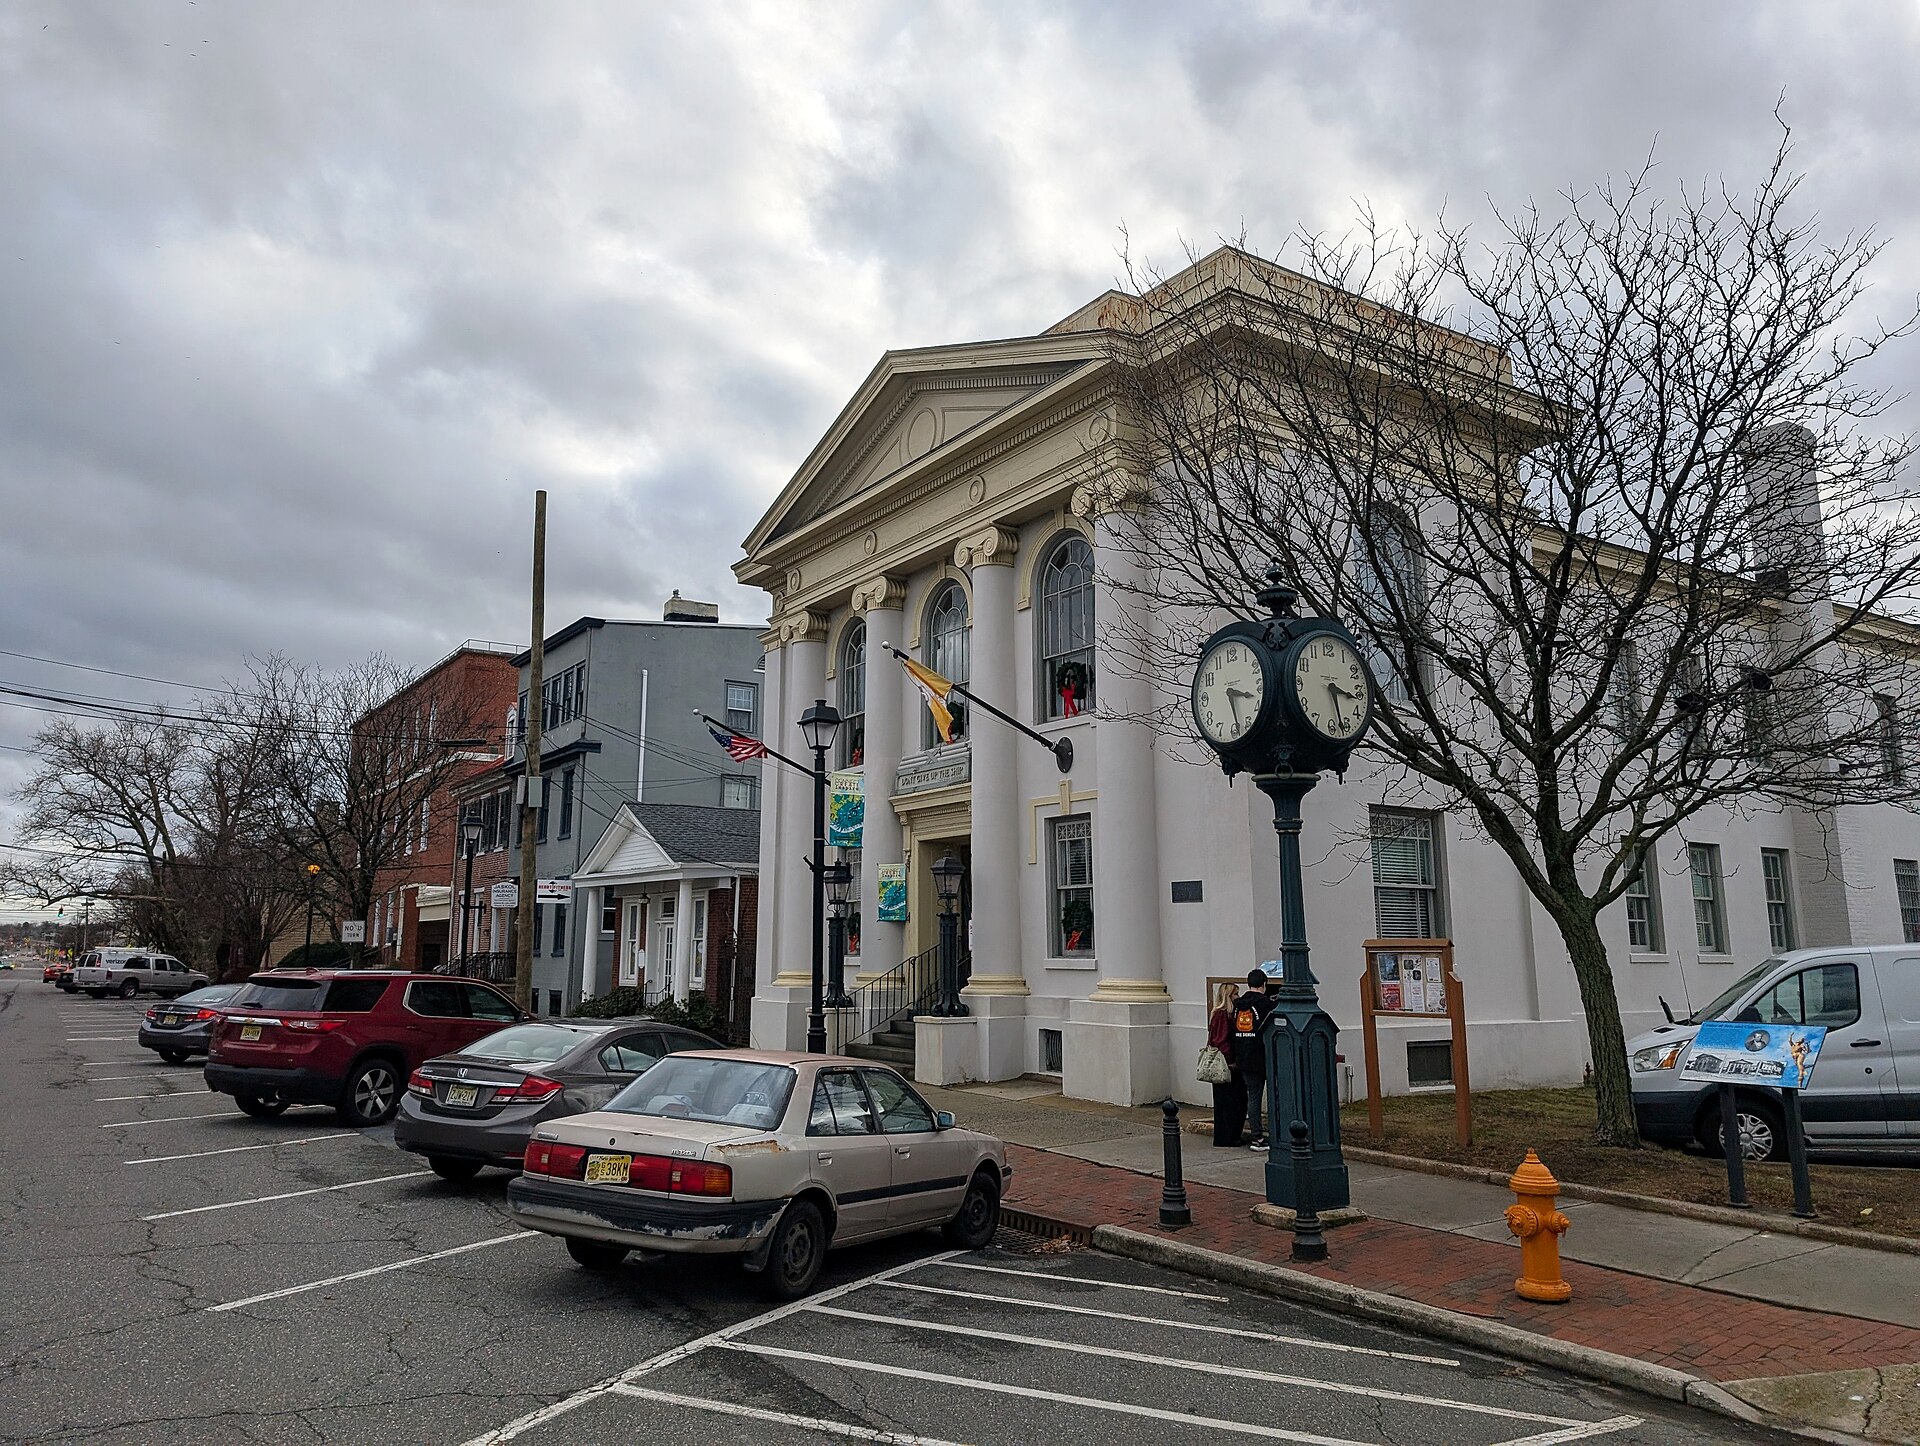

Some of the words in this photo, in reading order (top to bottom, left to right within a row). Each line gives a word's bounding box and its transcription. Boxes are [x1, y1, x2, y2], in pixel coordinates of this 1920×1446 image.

[1226, 646, 1238, 664] 12
[1244, 648, 1248, 663] 1
[1310, 644, 1318, 659] 11
[1322, 641, 1335, 658] 12
[1341, 649, 1345, 664] 1
[1215, 655, 1222, 671] 11
[1251, 659, 1261, 675] 2
[1299, 657, 1309, 673] 10
[1205, 671, 1214, 688] 10
[1349, 664, 1360, 680] 2
[1296, 675, 1304, 692] 9
[1201, 691, 1209, 708] 9
[1354, 684, 1364, 701] 3
[1301, 696, 1308, 713] 8
[1352, 704, 1362, 720] 4
[1206, 710, 1214, 726] 8
[1311, 712, 1320, 728] 7
[1343, 716, 1351, 733] 5
[1215, 721, 1224, 738] 7
[1230, 722, 1239, 740] 6
[1327, 718, 1336, 736] 6
[916, 773, 930, 783] GIVE
[930, 771, 938, 781] UP
[939, 769, 950, 779] THE
[950, 766, 964, 777] SHIP
